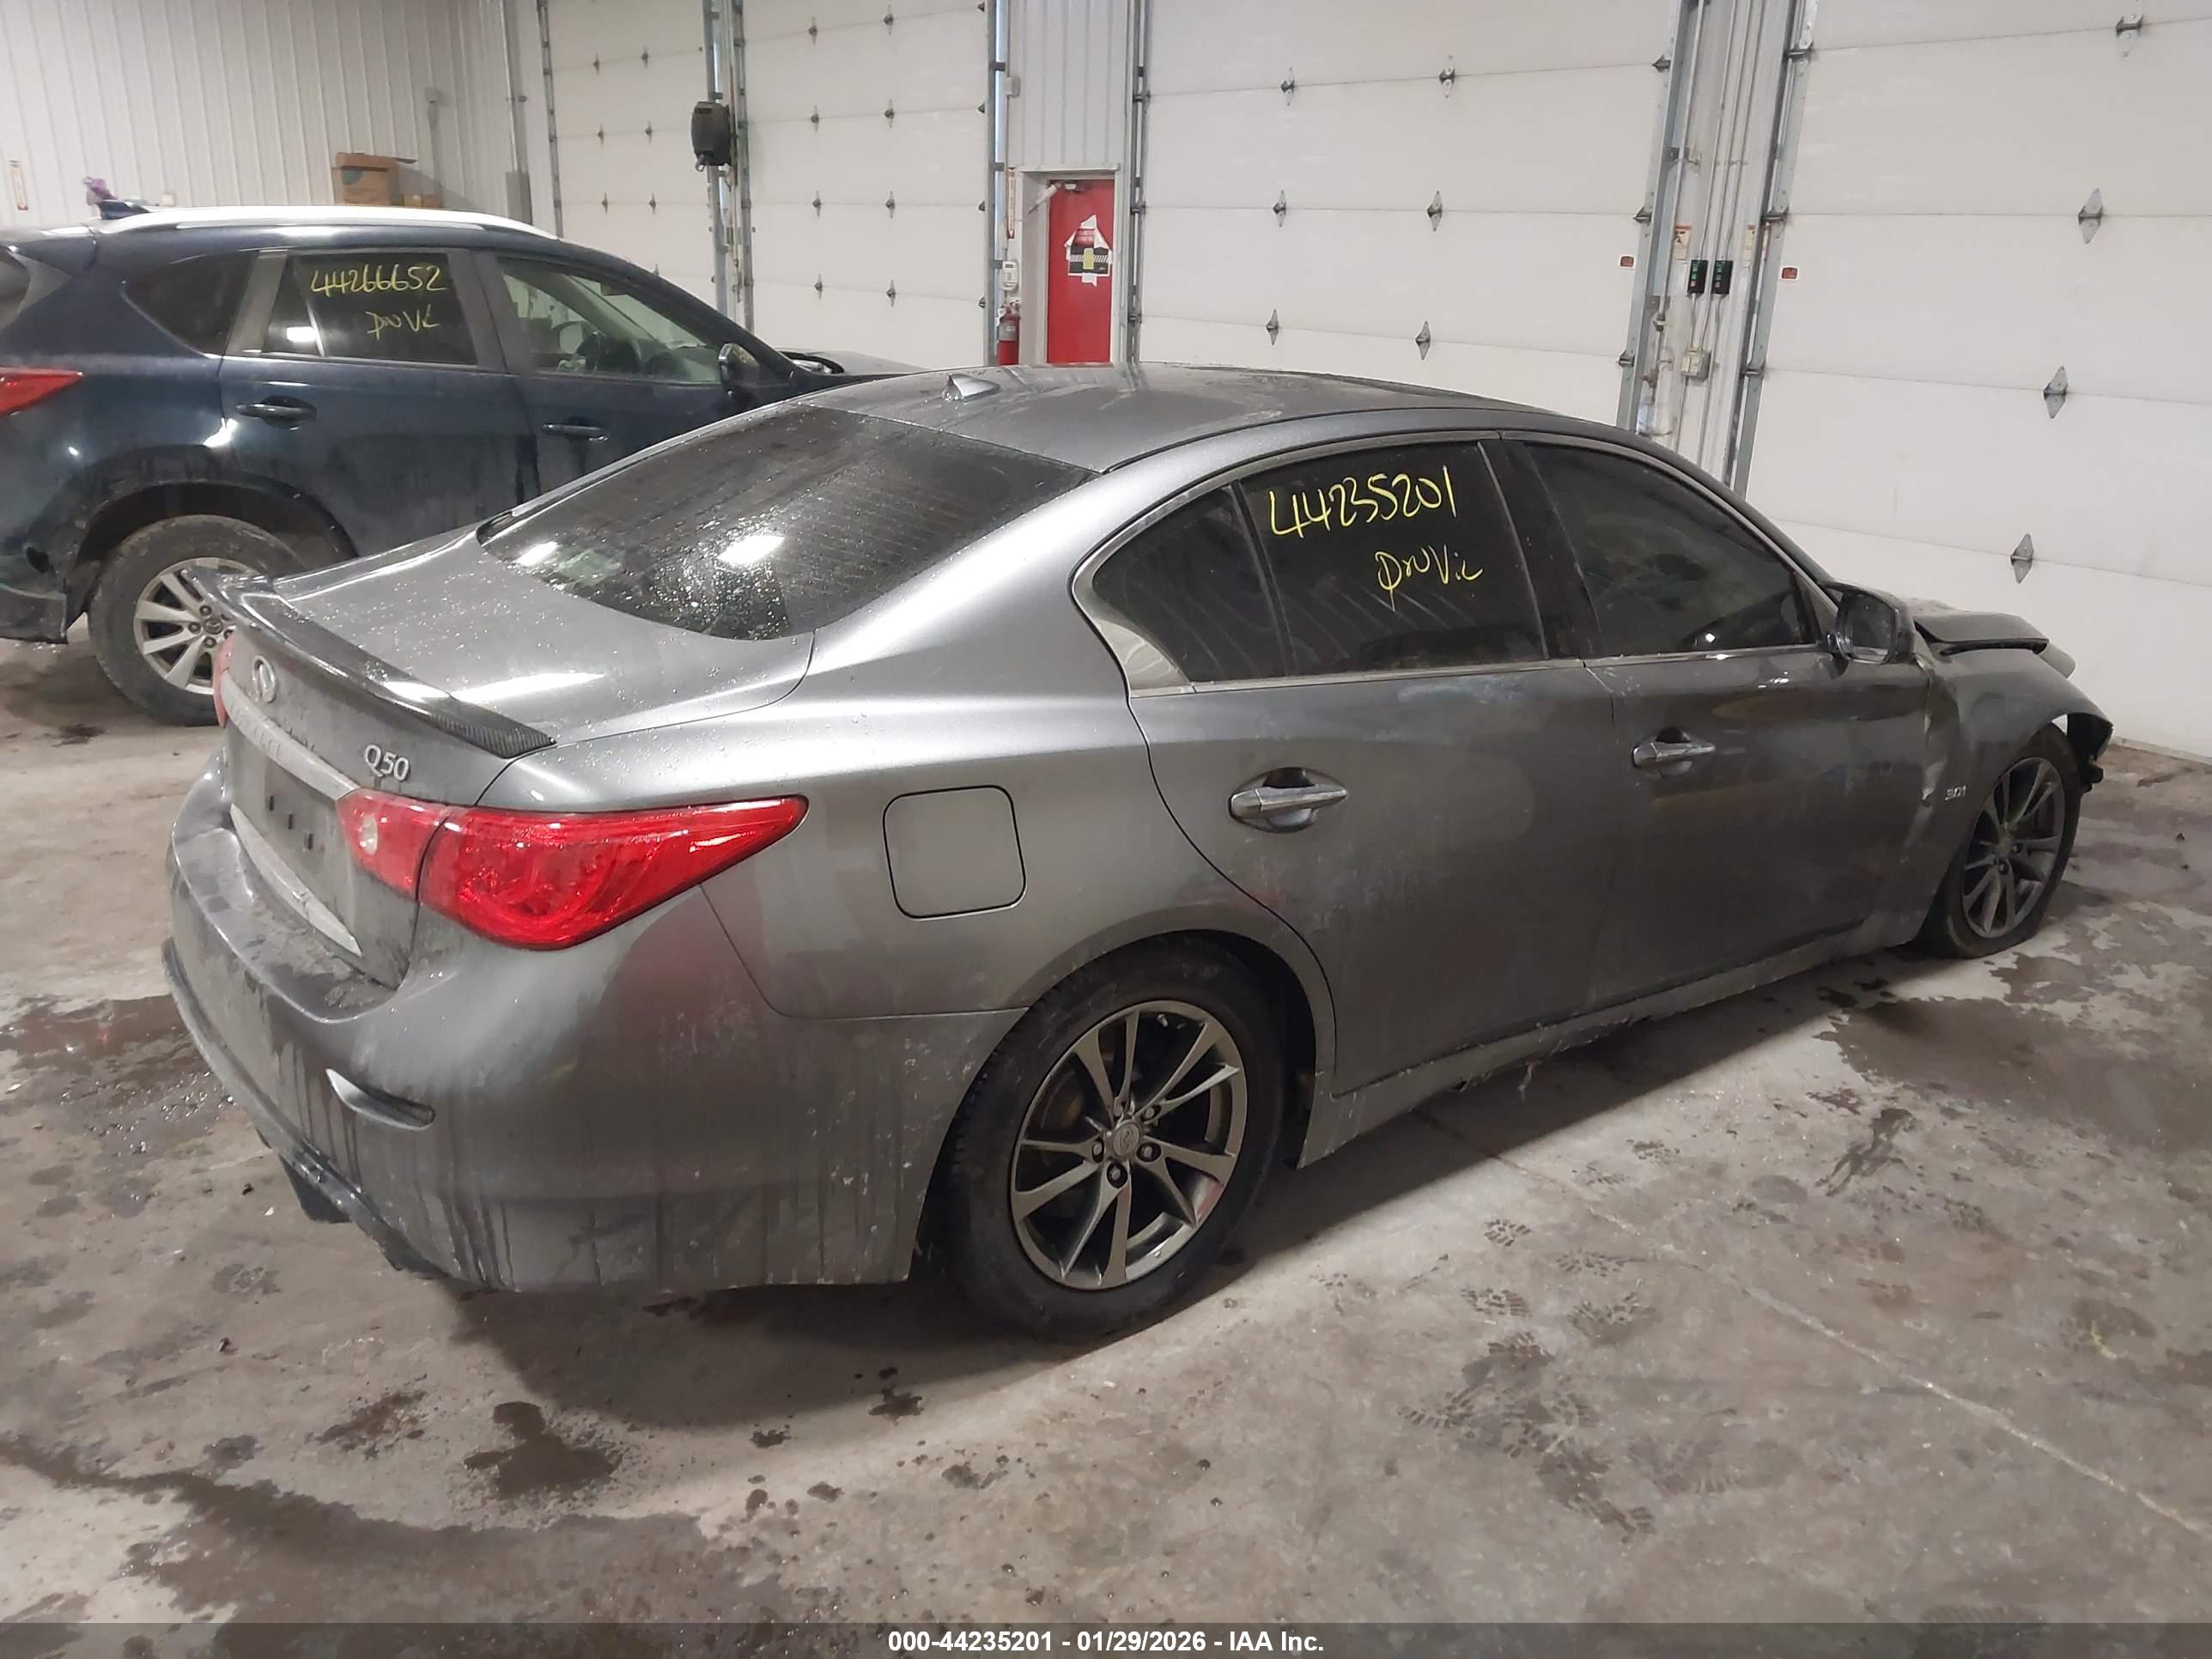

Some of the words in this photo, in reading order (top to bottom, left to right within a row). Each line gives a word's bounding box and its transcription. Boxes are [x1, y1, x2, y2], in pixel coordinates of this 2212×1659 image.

[310, 263, 448, 298] 44266652
[1268, 464, 1457, 539] 44235201
[363, 744, 410, 782] Q50
